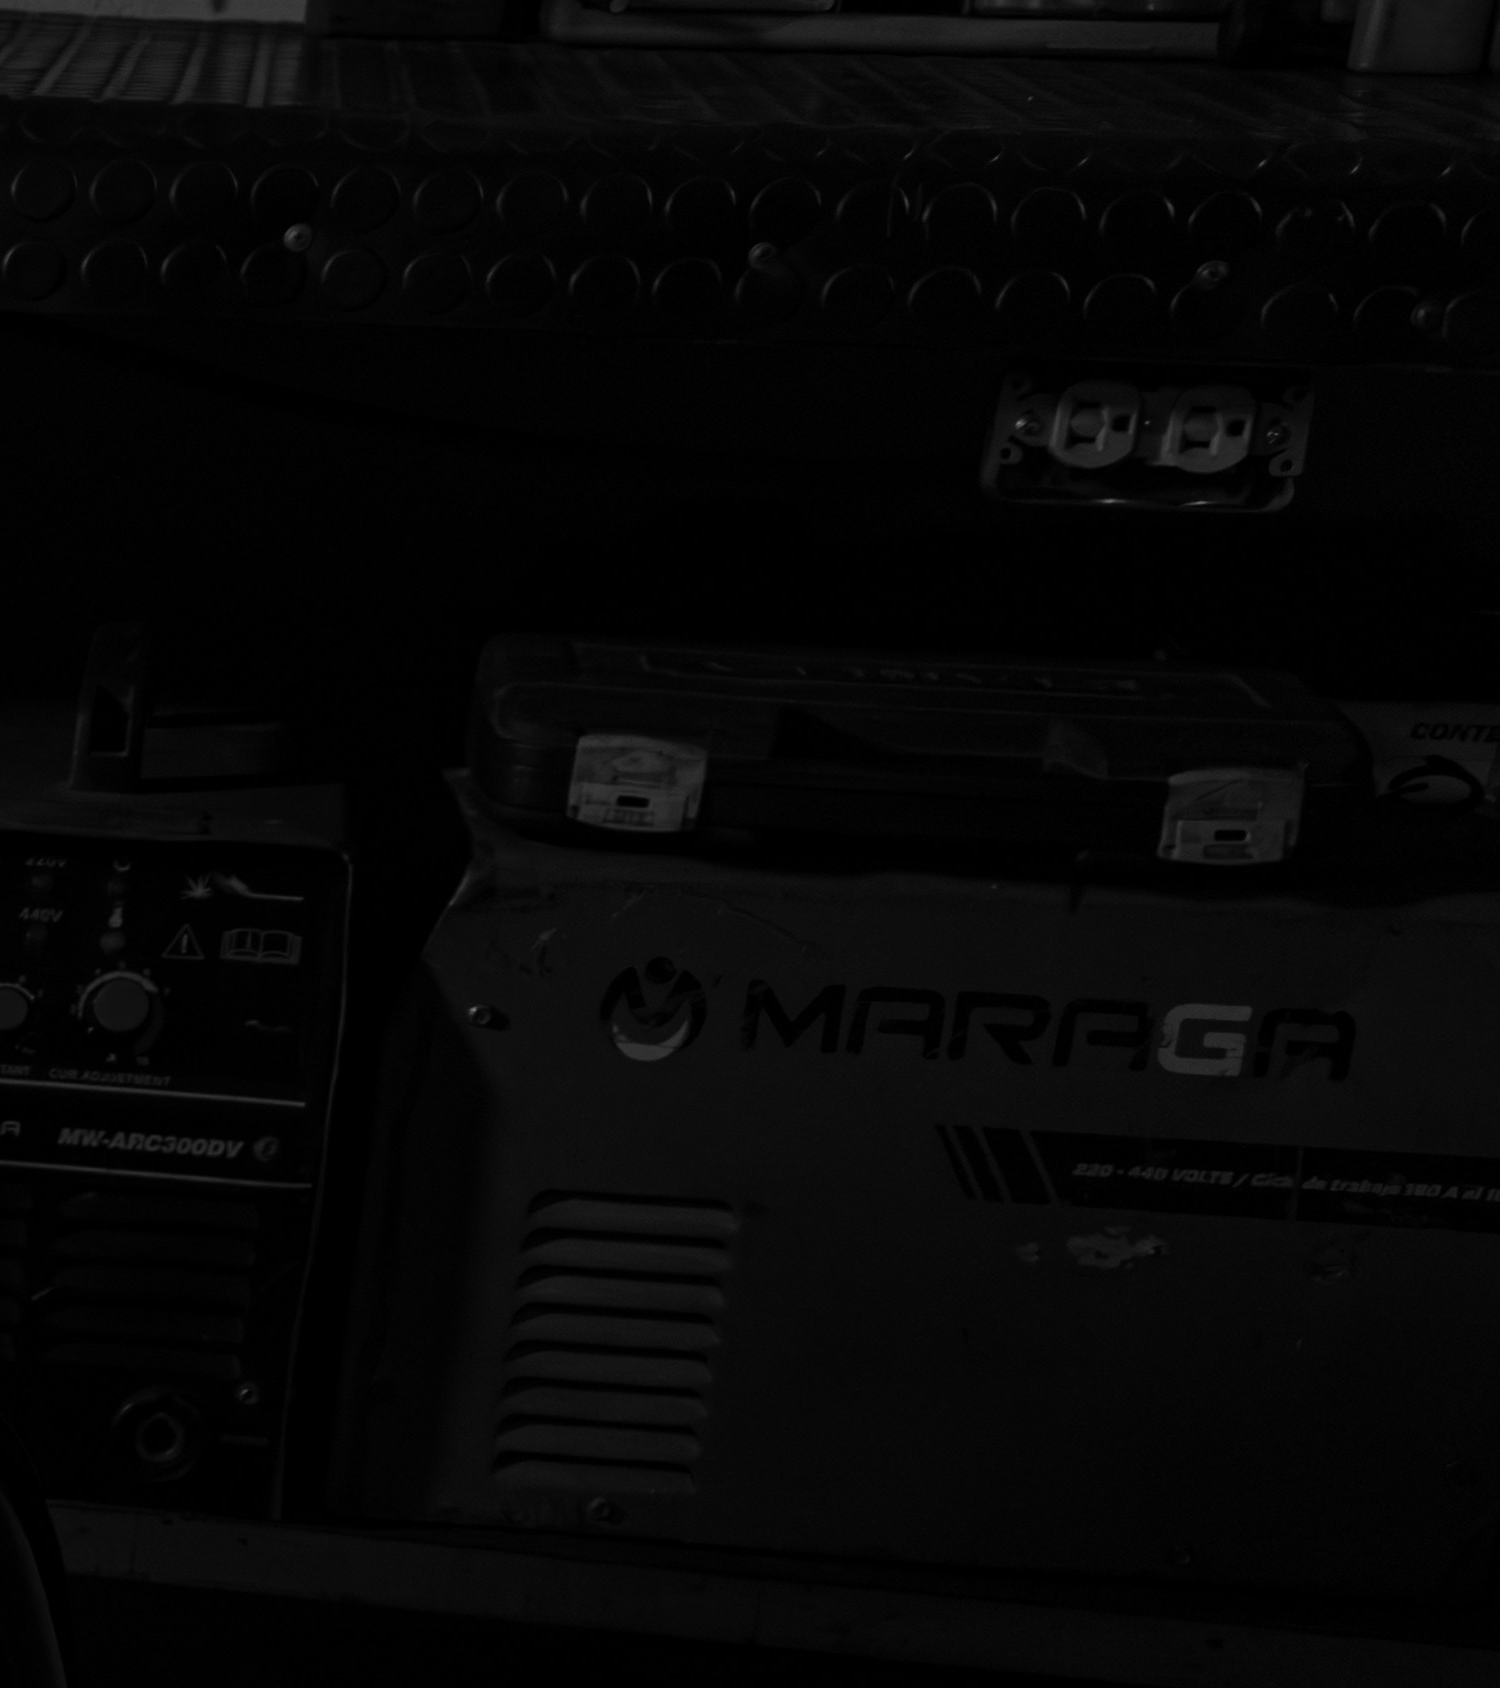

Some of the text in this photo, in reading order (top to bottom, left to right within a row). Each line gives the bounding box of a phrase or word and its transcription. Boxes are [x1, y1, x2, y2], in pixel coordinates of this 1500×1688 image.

[18, 906, 63, 923] 440V
[742, 978, 1356, 1082] MARAGA
[56, 1127, 244, 1159] MW-ARC300DV
[1071, 1163, 1114, 1178] 220
[1127, 1165, 1169, 1180] 440
[1171, 1168, 1234, 1185] VOLTS
